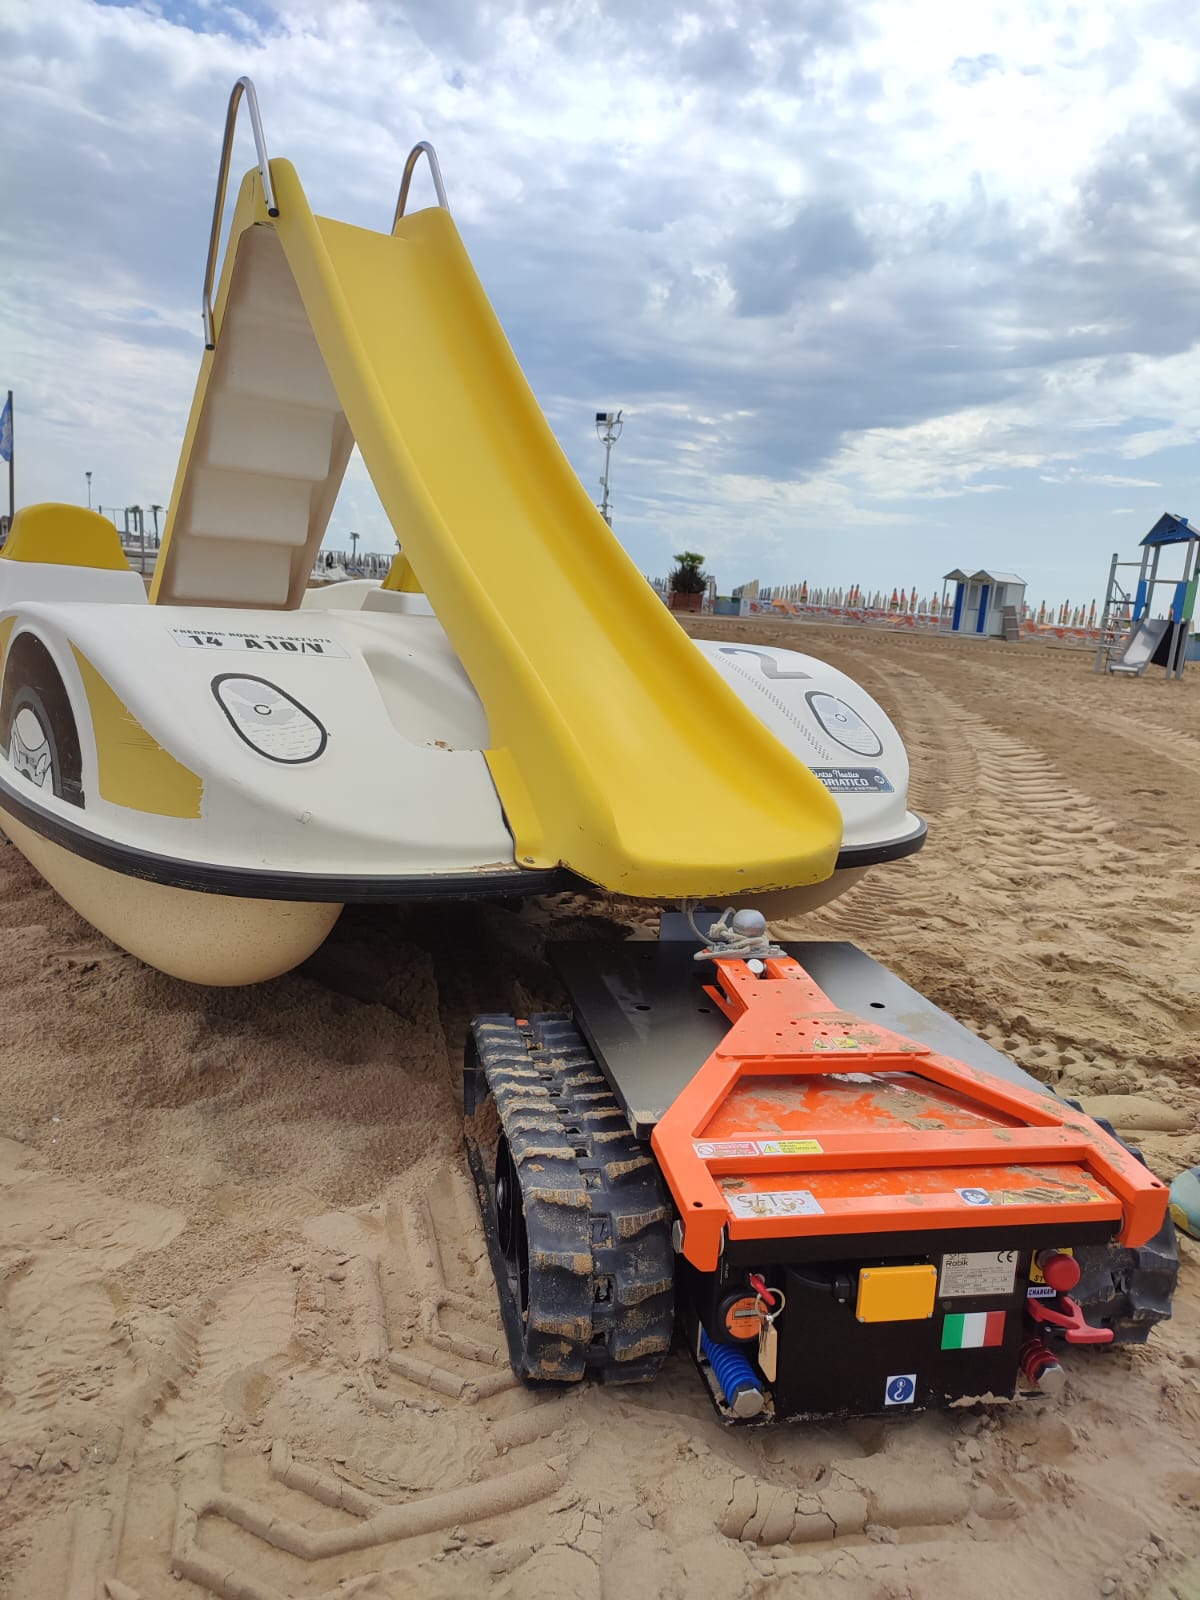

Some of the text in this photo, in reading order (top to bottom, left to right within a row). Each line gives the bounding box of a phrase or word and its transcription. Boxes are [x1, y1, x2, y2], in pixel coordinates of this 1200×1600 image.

[188, 635, 223, 647] 14
[818, 778, 869, 786] DRIATICO
[945, 1259, 969, 1267] Robik
[1028, 1288, 1054, 1297] CHARGER
